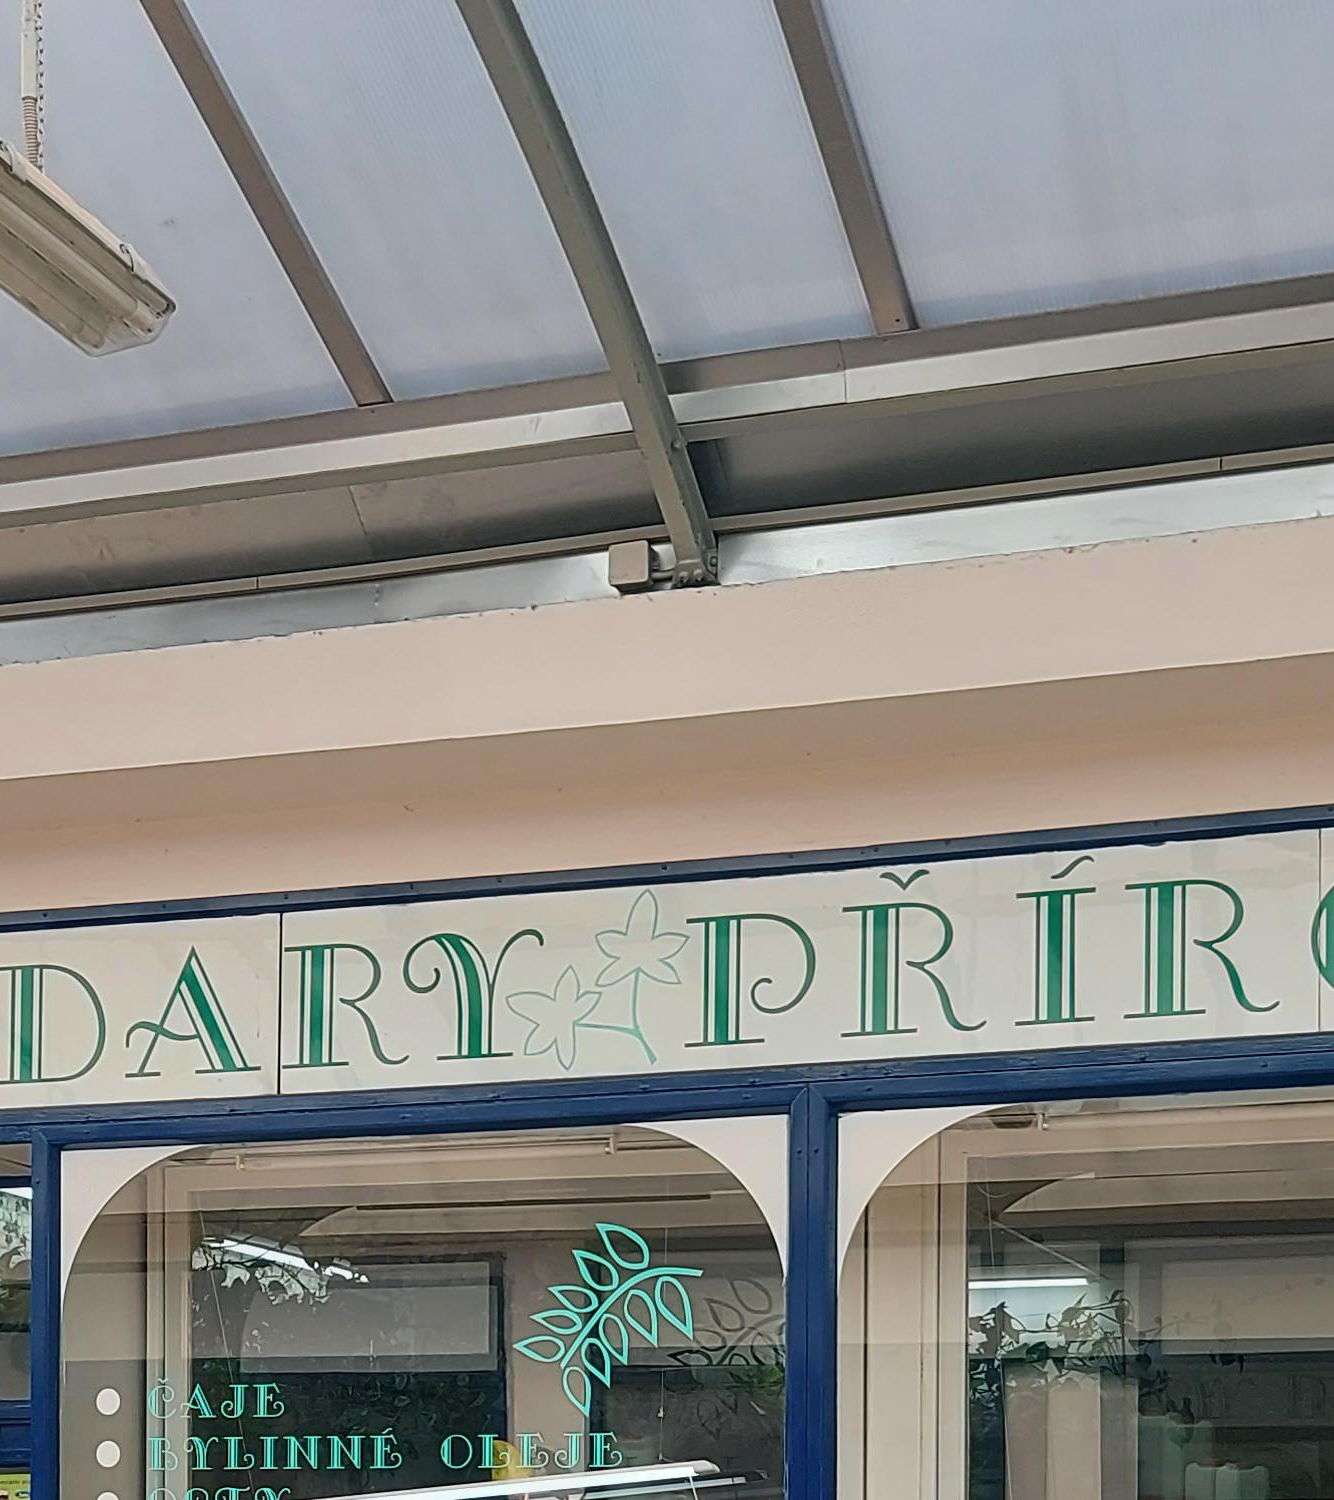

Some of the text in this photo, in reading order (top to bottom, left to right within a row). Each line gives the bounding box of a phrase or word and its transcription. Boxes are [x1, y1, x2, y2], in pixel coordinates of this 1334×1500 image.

[147, 1378, 284, 1419] ČAJE
[148, 1427, 624, 1470] BYLINNÉ OLEJE
